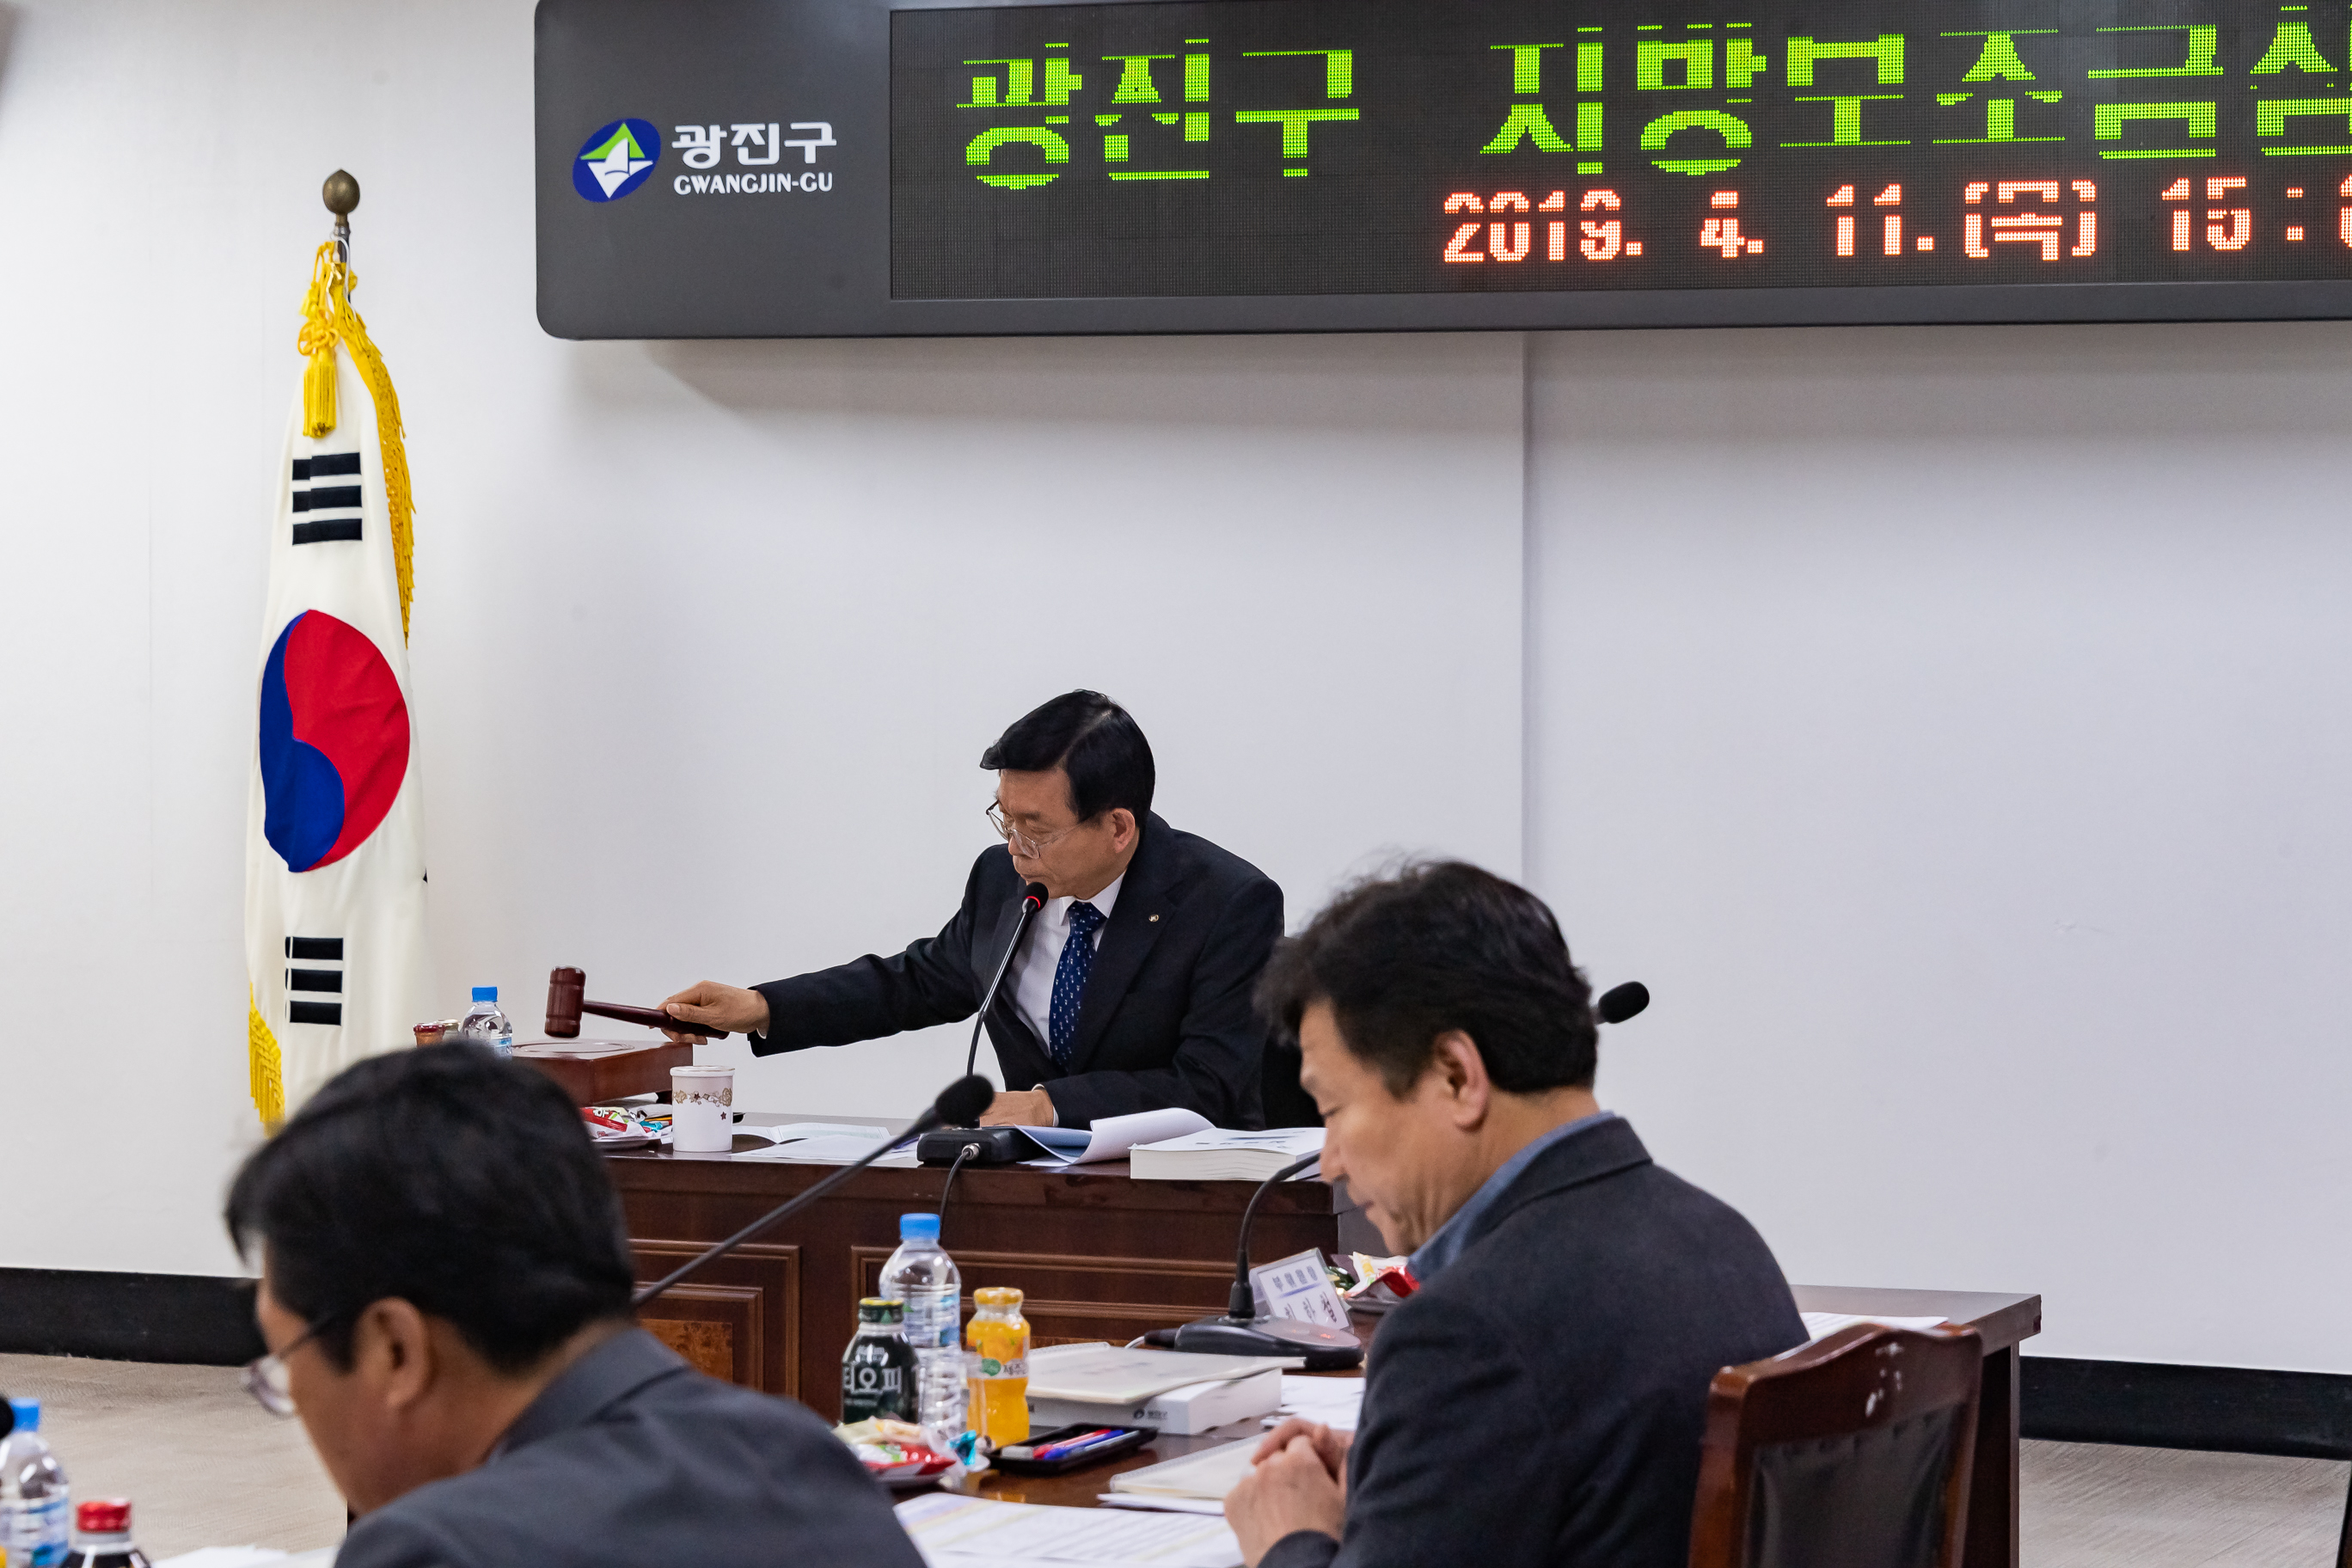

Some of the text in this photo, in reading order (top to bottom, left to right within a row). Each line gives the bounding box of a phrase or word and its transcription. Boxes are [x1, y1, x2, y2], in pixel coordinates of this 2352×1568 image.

[956, 38, 1360, 190] 광진구
[671, 121, 837, 169] 광진구
[673, 171, 833, 195] GWANGJIN-GU
[1442, 188, 1644, 263] 2019.
[1700, 189, 1765, 259] 4.
